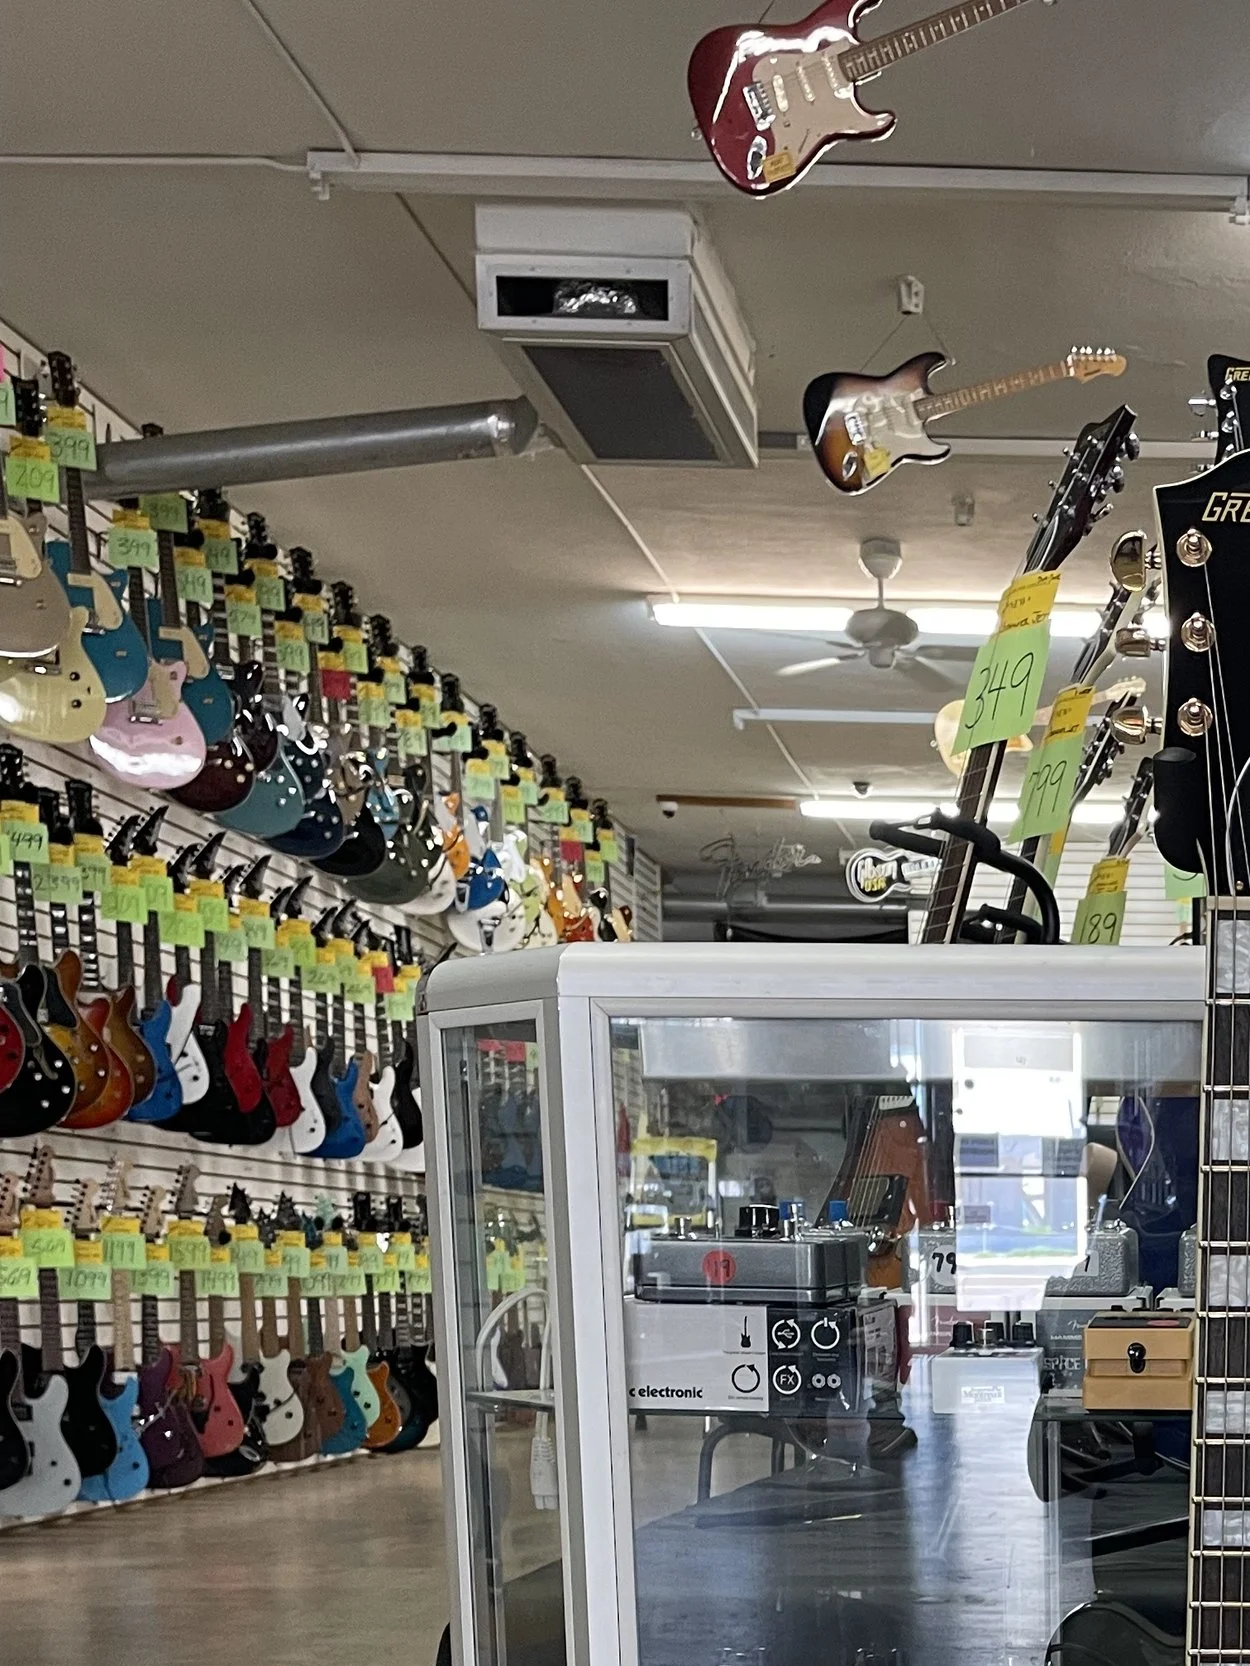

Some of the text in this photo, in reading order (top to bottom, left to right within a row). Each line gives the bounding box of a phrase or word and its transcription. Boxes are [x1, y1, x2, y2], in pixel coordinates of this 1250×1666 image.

[964, 651, 1034, 730] 349
[1029, 760, 1068, 818] 799
[863, 877, 887, 893] USA
[1080, 912, 1118, 945] 189
[931, 1251, 957, 1275] 79
[638, 1385, 703, 1399] electronic
[779, 1374, 795, 1386] FX
